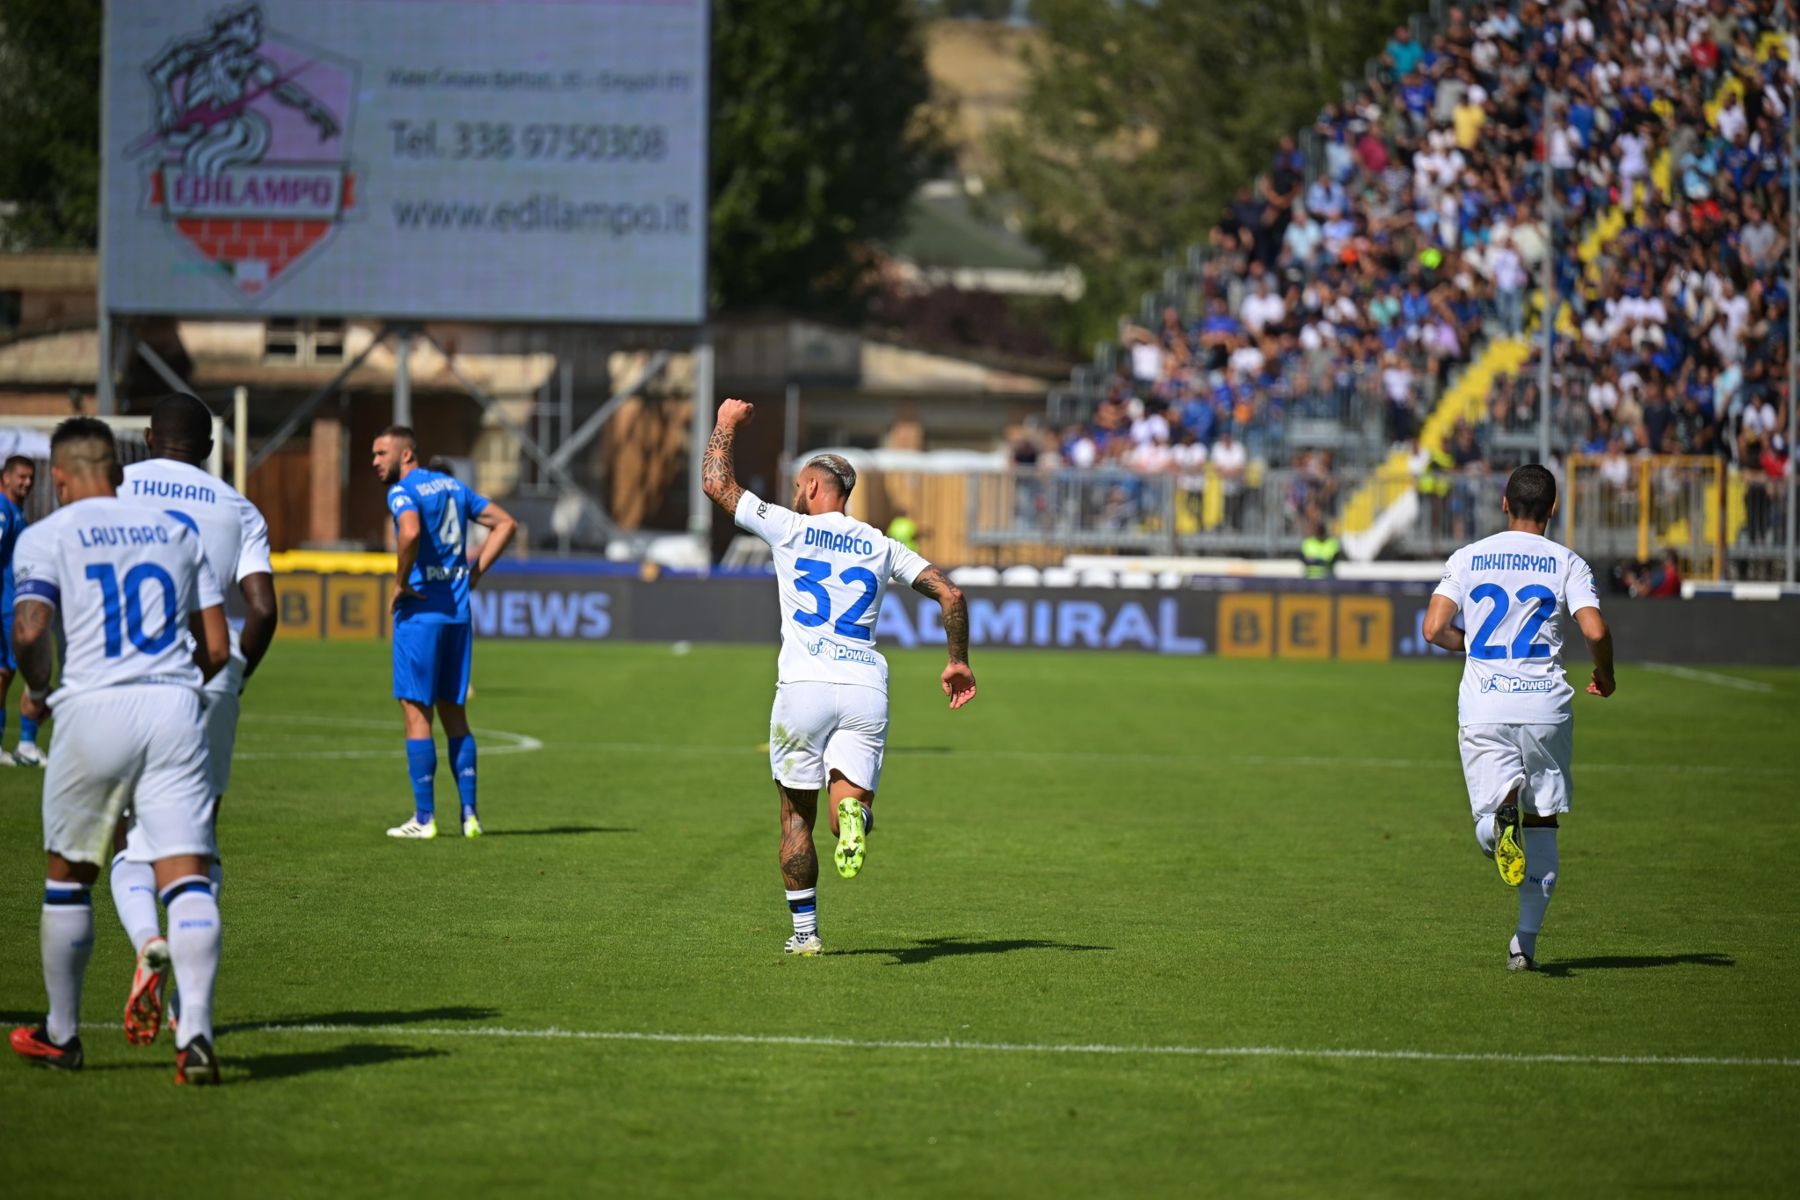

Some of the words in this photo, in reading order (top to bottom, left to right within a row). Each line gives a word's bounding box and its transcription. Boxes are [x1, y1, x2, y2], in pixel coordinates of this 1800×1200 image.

[388, 119, 445, 160] Tel.
[452, 120, 516, 161] 338
[521, 122, 668, 163] 9750308
[174, 175, 335, 209] EDILAMPO
[391, 191, 691, 237] www.edilampo.it
[132, 479, 216, 504] THURAM
[78, 525, 169, 548] LAUTARO
[439, 497, 462, 556] 4
[804, 527, 873, 555] DIMARCO
[1471, 553, 1557, 574] MKHITARYAN
[85, 562, 177, 658] 10
[282, 589, 367, 626] BE
[471, 591, 612, 639] NEWS
[792, 557, 878, 641] 32
[1468, 582, 1557, 660] 22
[875, 593, 1206, 655] ADMIRAL
[1230, 607, 1378, 648] BET
